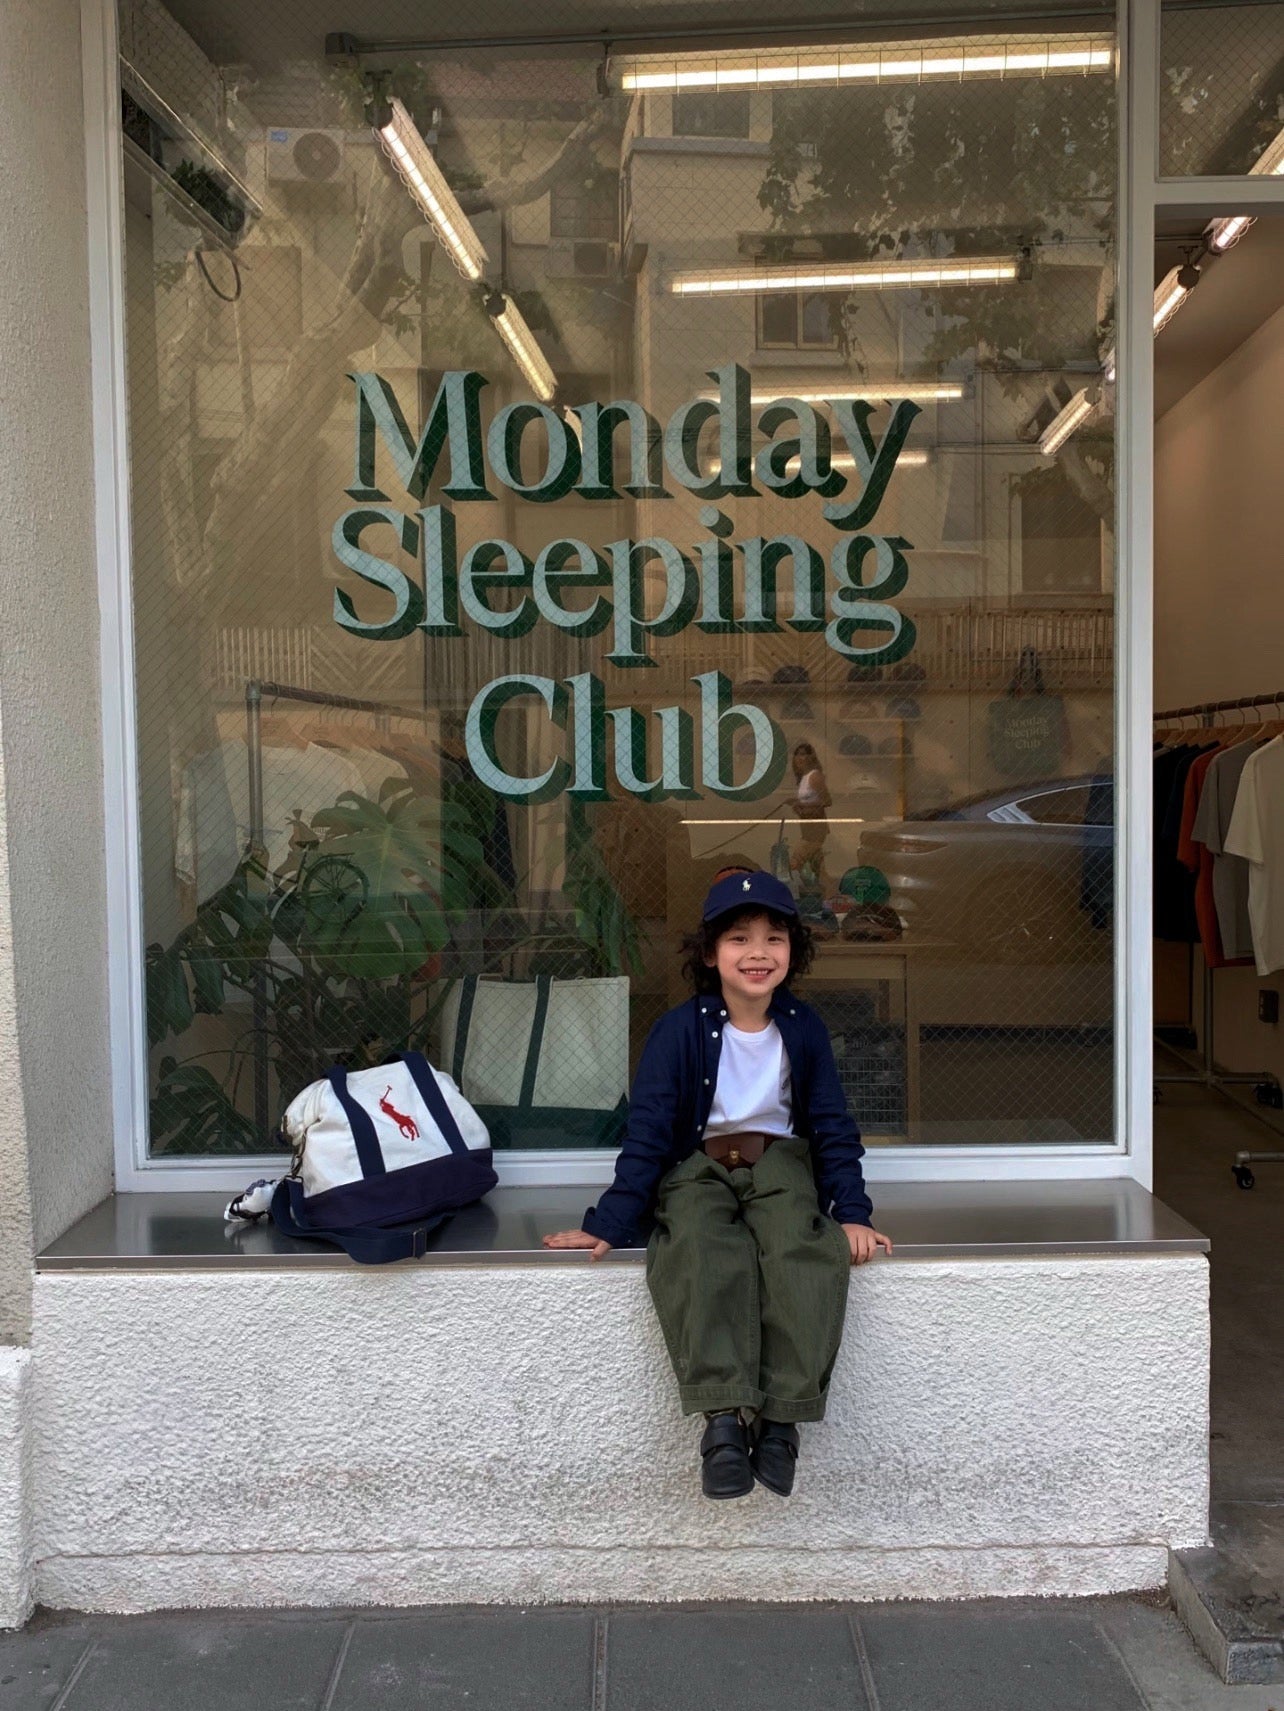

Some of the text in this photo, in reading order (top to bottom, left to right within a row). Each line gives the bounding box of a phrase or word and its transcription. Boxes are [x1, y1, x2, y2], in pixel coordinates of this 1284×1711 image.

[345, 363, 923, 530] Monday
[331, 504, 917, 667] Sleeping
[465, 670, 788, 804] Club
